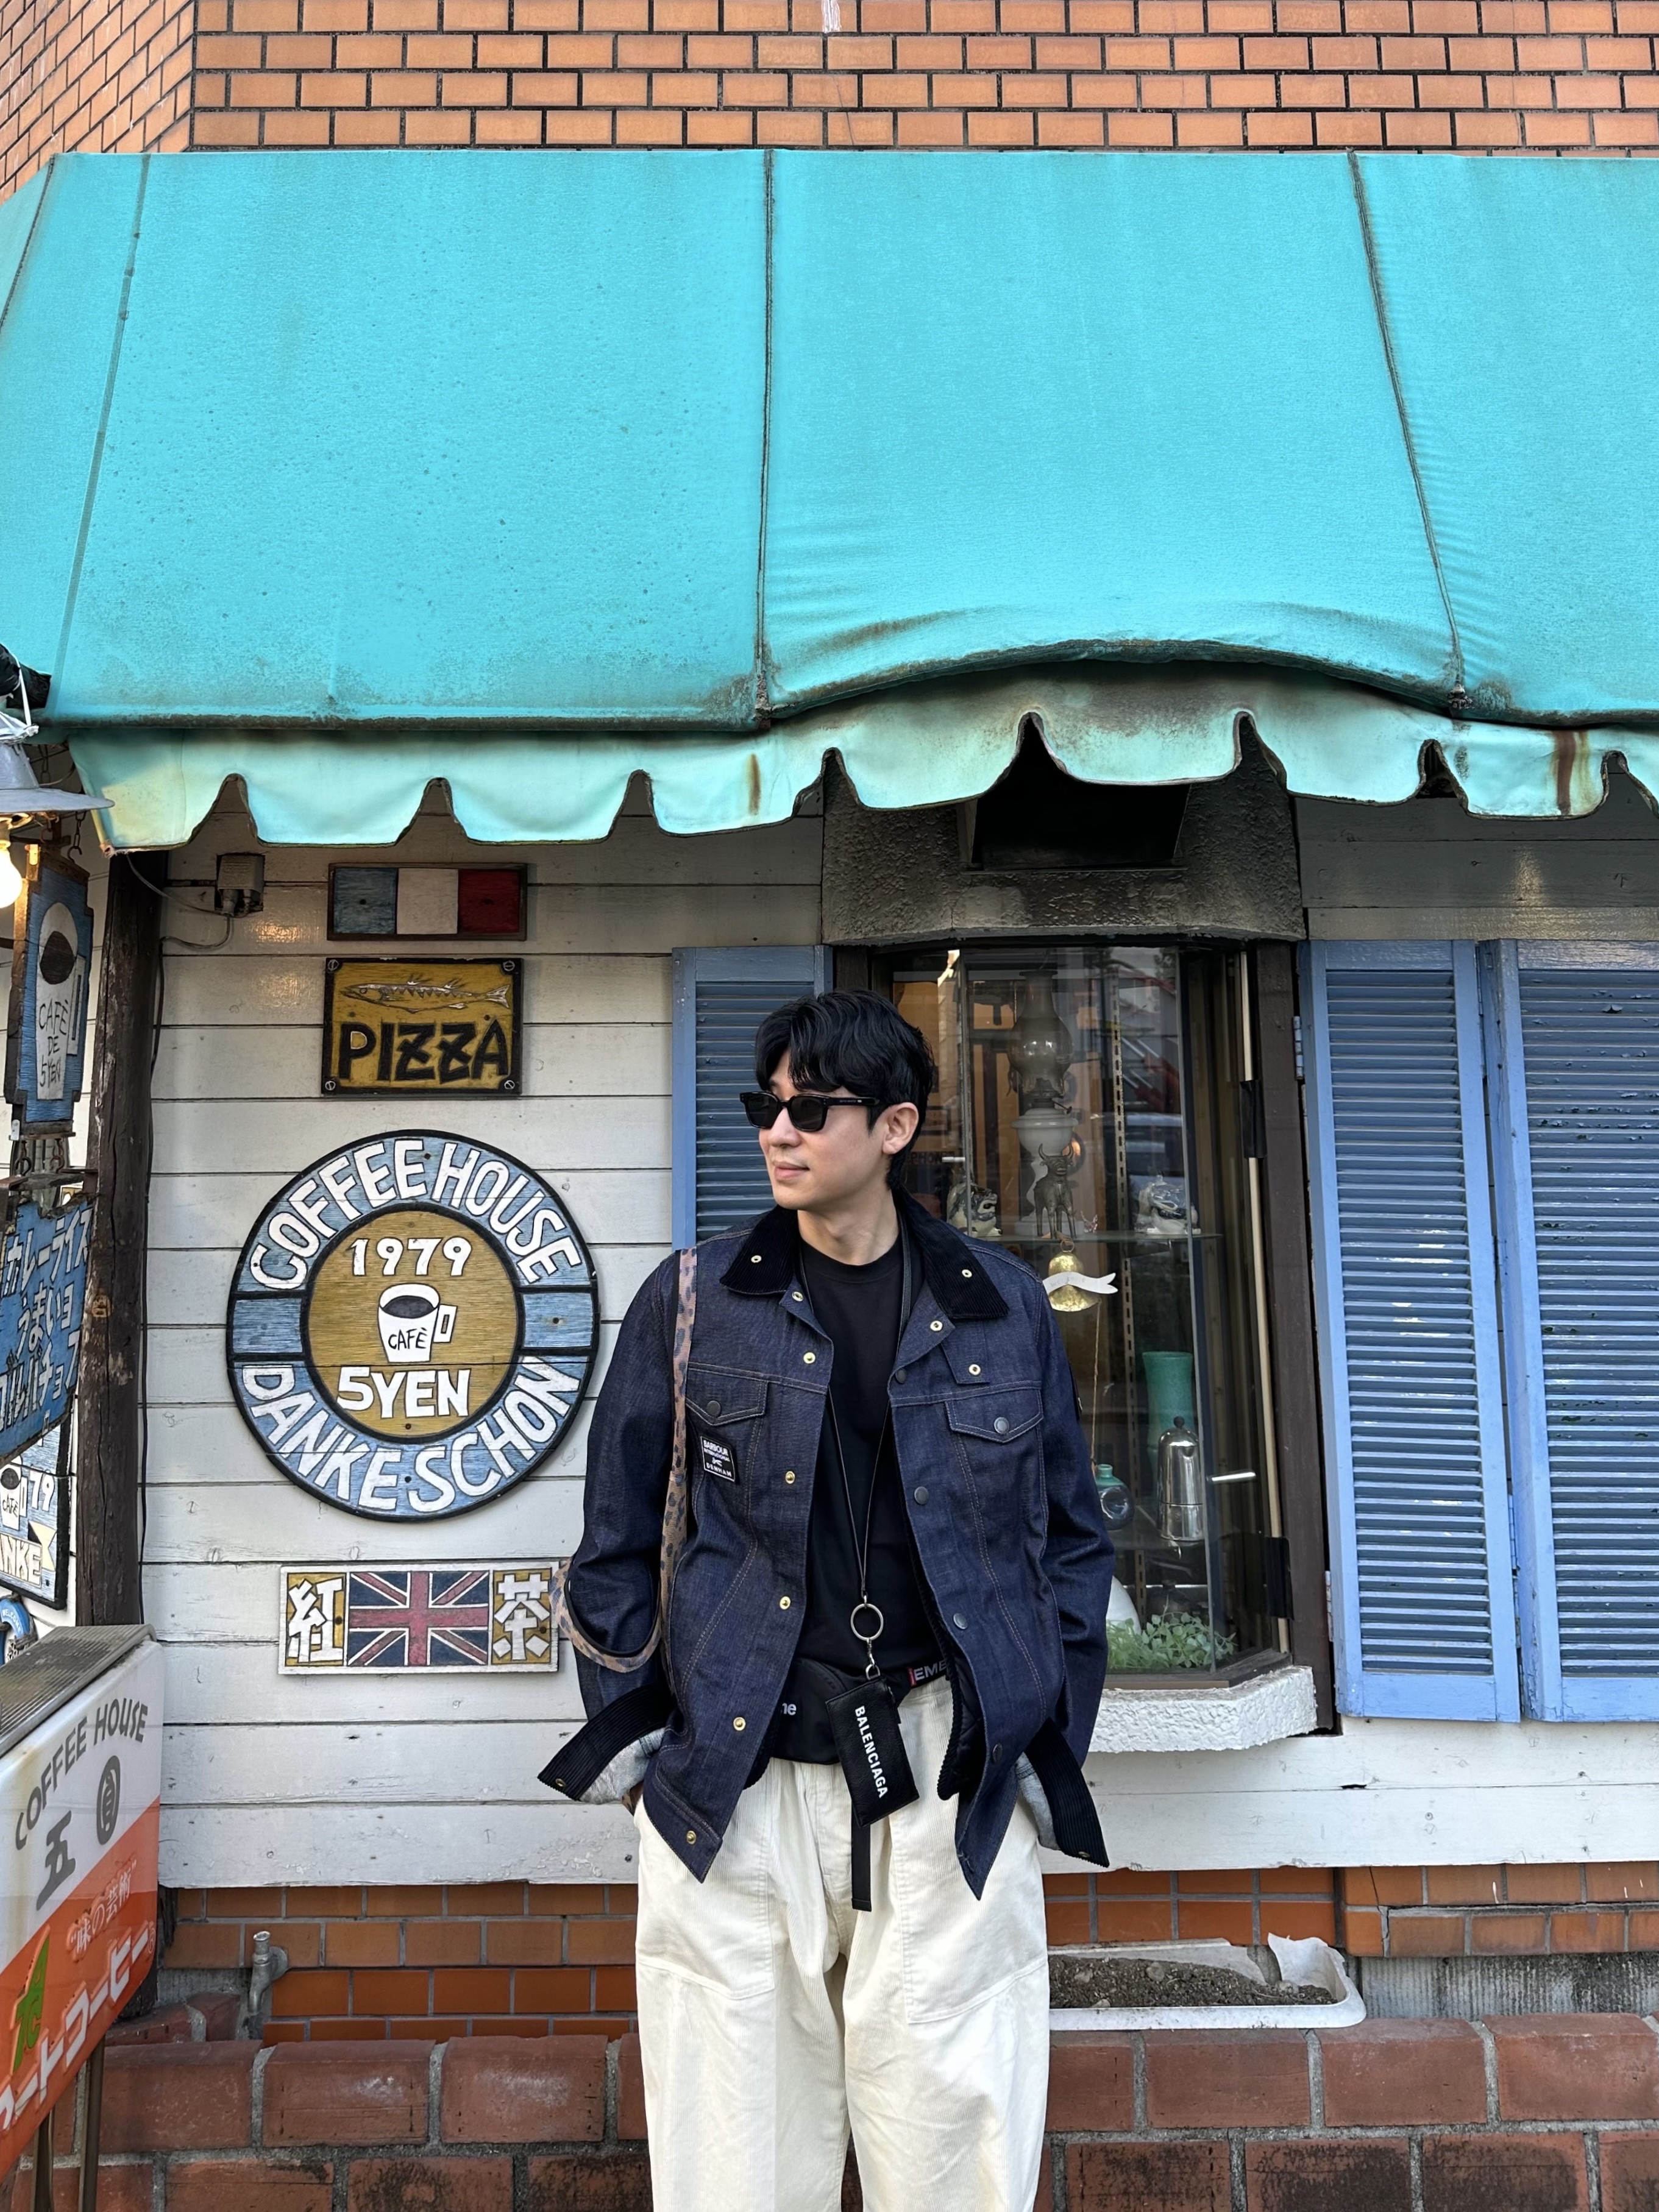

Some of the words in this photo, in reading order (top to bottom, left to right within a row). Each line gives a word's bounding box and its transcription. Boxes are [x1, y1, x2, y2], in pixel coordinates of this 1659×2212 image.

[40, 1055, 61, 1088] 5YEN
[48, 1036, 60, 1056] DE
[338, 1019, 508, 1084] PIZZA
[250, 1139, 427, 1289] COFFEE
[432, 1143, 581, 1285] HOUSE
[350, 1237, 472, 1276] 1979
[337, 1366, 472, 1419] 5YEN
[243, 1364, 401, 1510] DANKE
[408, 1355, 580, 1513] SCHON
[706, 1462, 731, 1477] DENHAM
[288, 1579, 343, 1663] 紅
[494, 1573, 550, 1661] 茶
[15, 1716, 87, 1850] COFFEE
[94, 1698, 148, 1746] HOUSE
[855, 1706, 888, 1798] BALENCIAGA
[37, 1810, 76, 1911] 五
